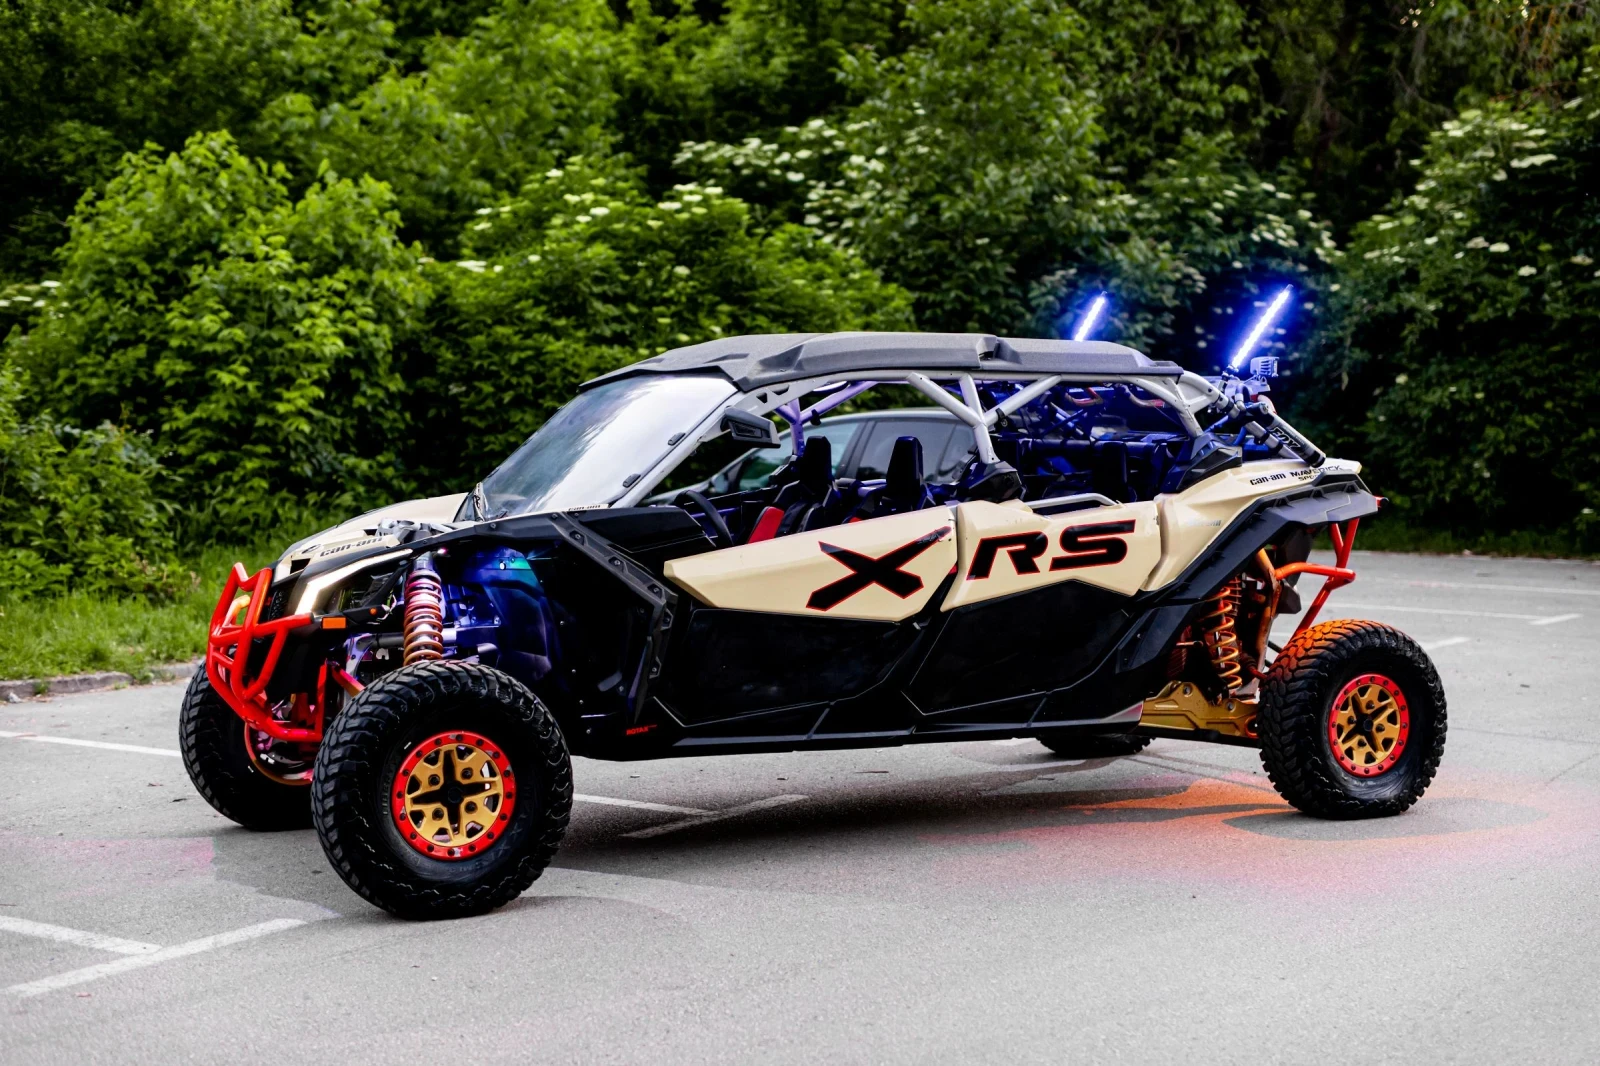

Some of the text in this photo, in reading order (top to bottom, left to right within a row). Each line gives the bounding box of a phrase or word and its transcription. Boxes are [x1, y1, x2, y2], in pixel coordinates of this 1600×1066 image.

[1249, 472, 1287, 486] can-am
[320, 537, 383, 558] can-am
[805, 519, 1136, 612] X RS
